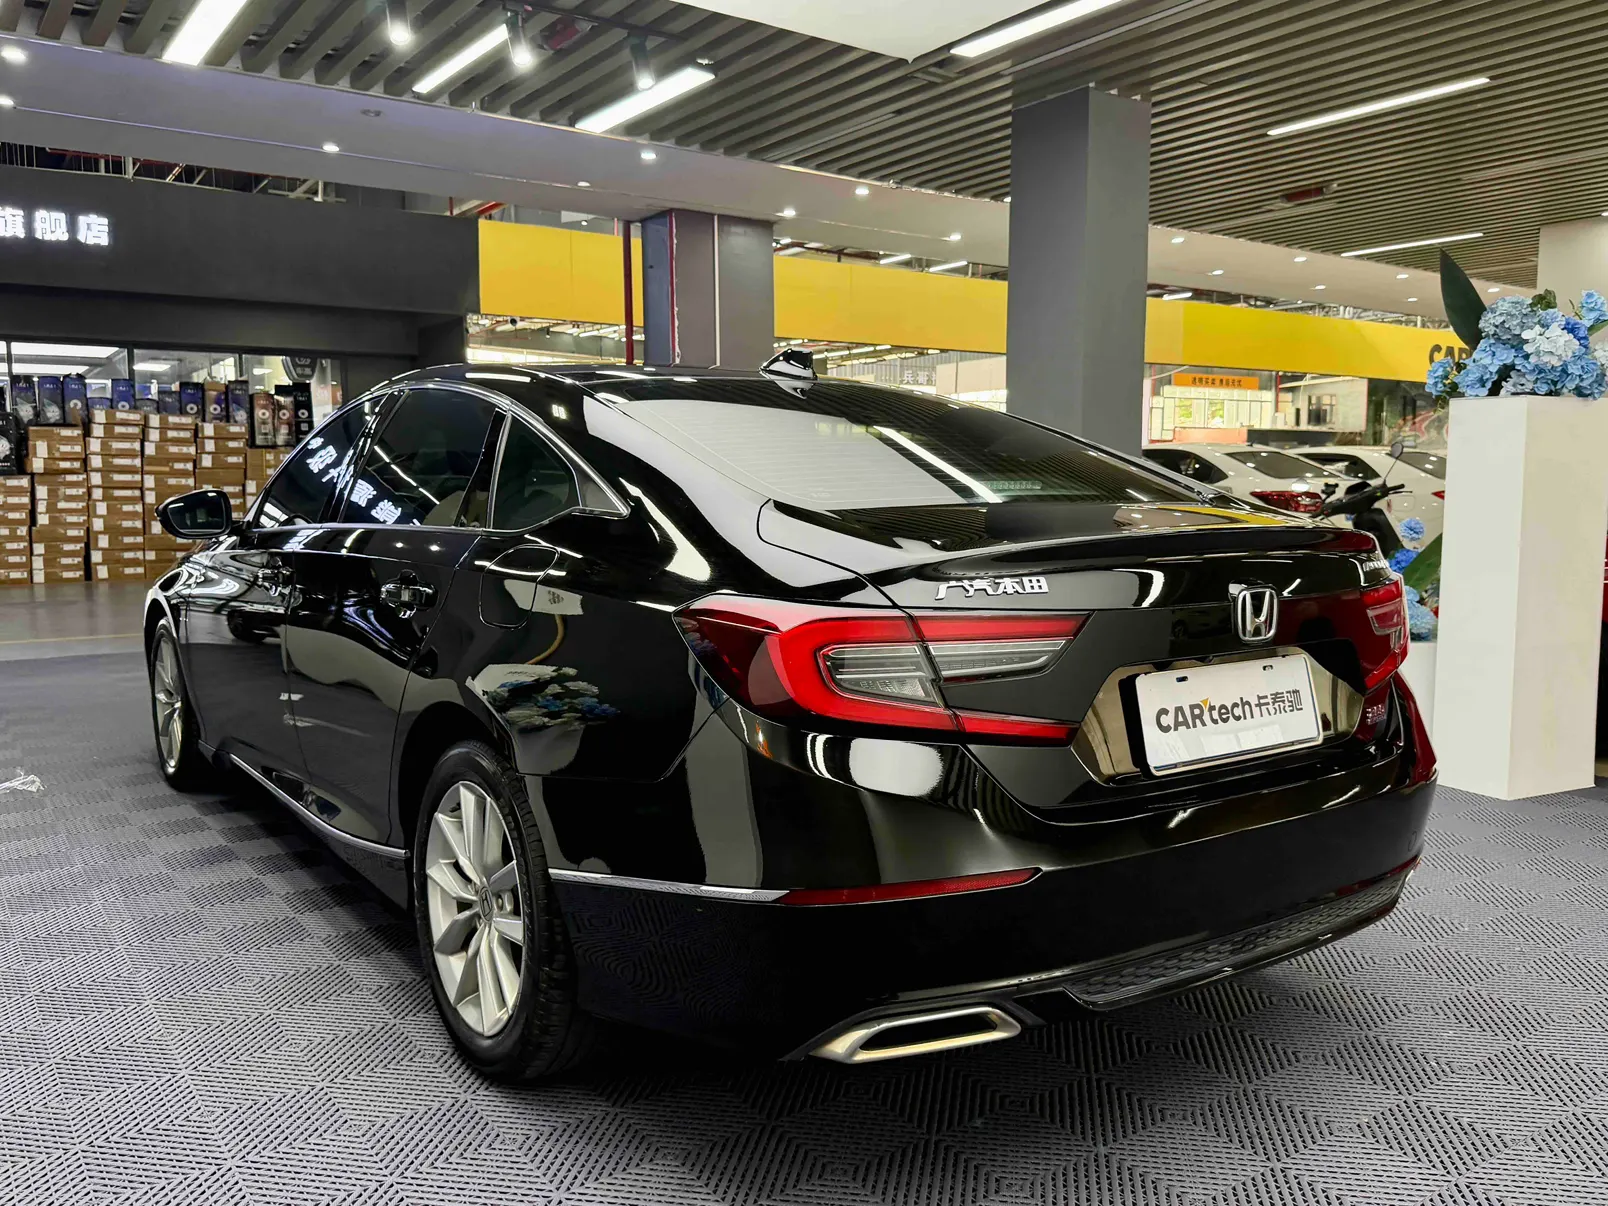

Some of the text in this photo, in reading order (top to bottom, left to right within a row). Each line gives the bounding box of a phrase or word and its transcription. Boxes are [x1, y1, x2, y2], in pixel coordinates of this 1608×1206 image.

[0, 206, 110, 246] 旗舰店
[935, 576, 1049, 600] 广汽本田
